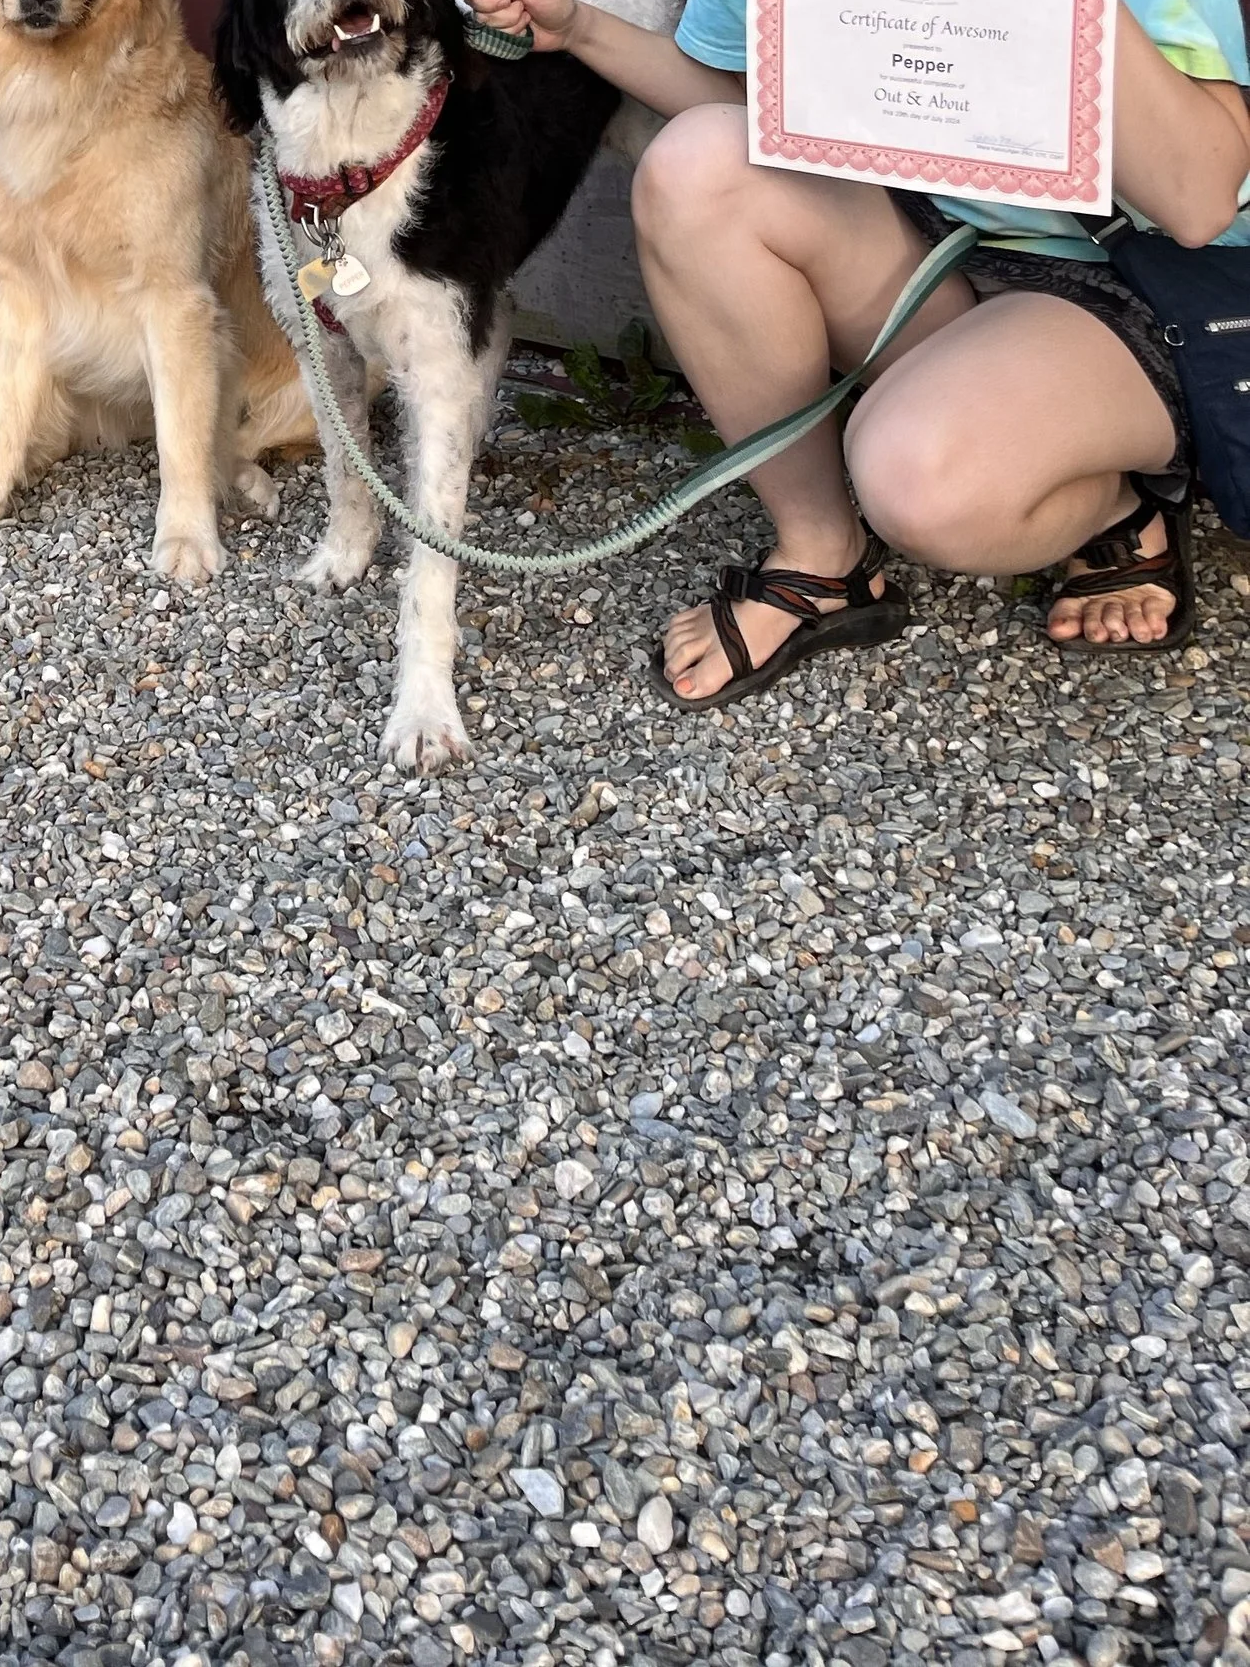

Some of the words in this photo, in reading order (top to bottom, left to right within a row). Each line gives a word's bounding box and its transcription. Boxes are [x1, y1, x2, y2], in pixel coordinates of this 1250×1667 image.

[839, 9, 917, 35] Certificate
[921, 16, 940, 40] of
[940, 20, 1009, 42] Awesome
[891, 53, 954, 75] Pepper
[873, 87, 903, 104] Out
[906, 90, 923, 106] &
[928, 92, 971, 112] About
